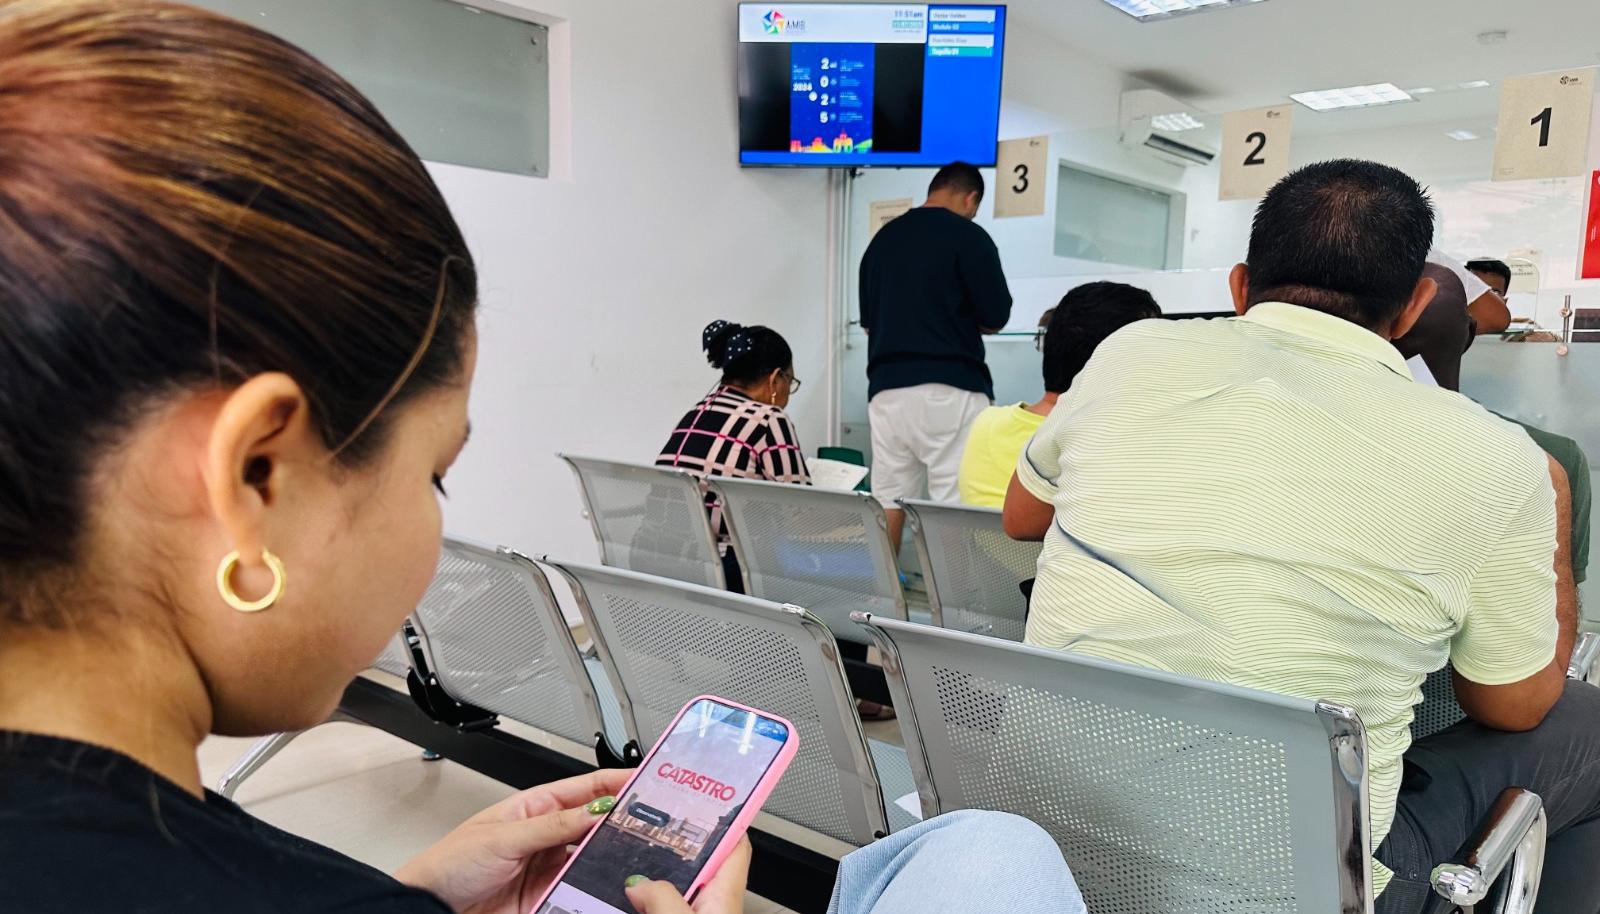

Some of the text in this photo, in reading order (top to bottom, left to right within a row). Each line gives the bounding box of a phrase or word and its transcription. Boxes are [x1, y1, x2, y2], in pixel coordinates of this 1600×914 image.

[821, 57, 830, 70] 2
[820, 93, 829, 106] 2
[1530, 107, 1552, 147] 1
[1243, 131, 1266, 166] 2
[1012, 163, 1029, 195] 3
[657, 762, 736, 802] CATASTRO
